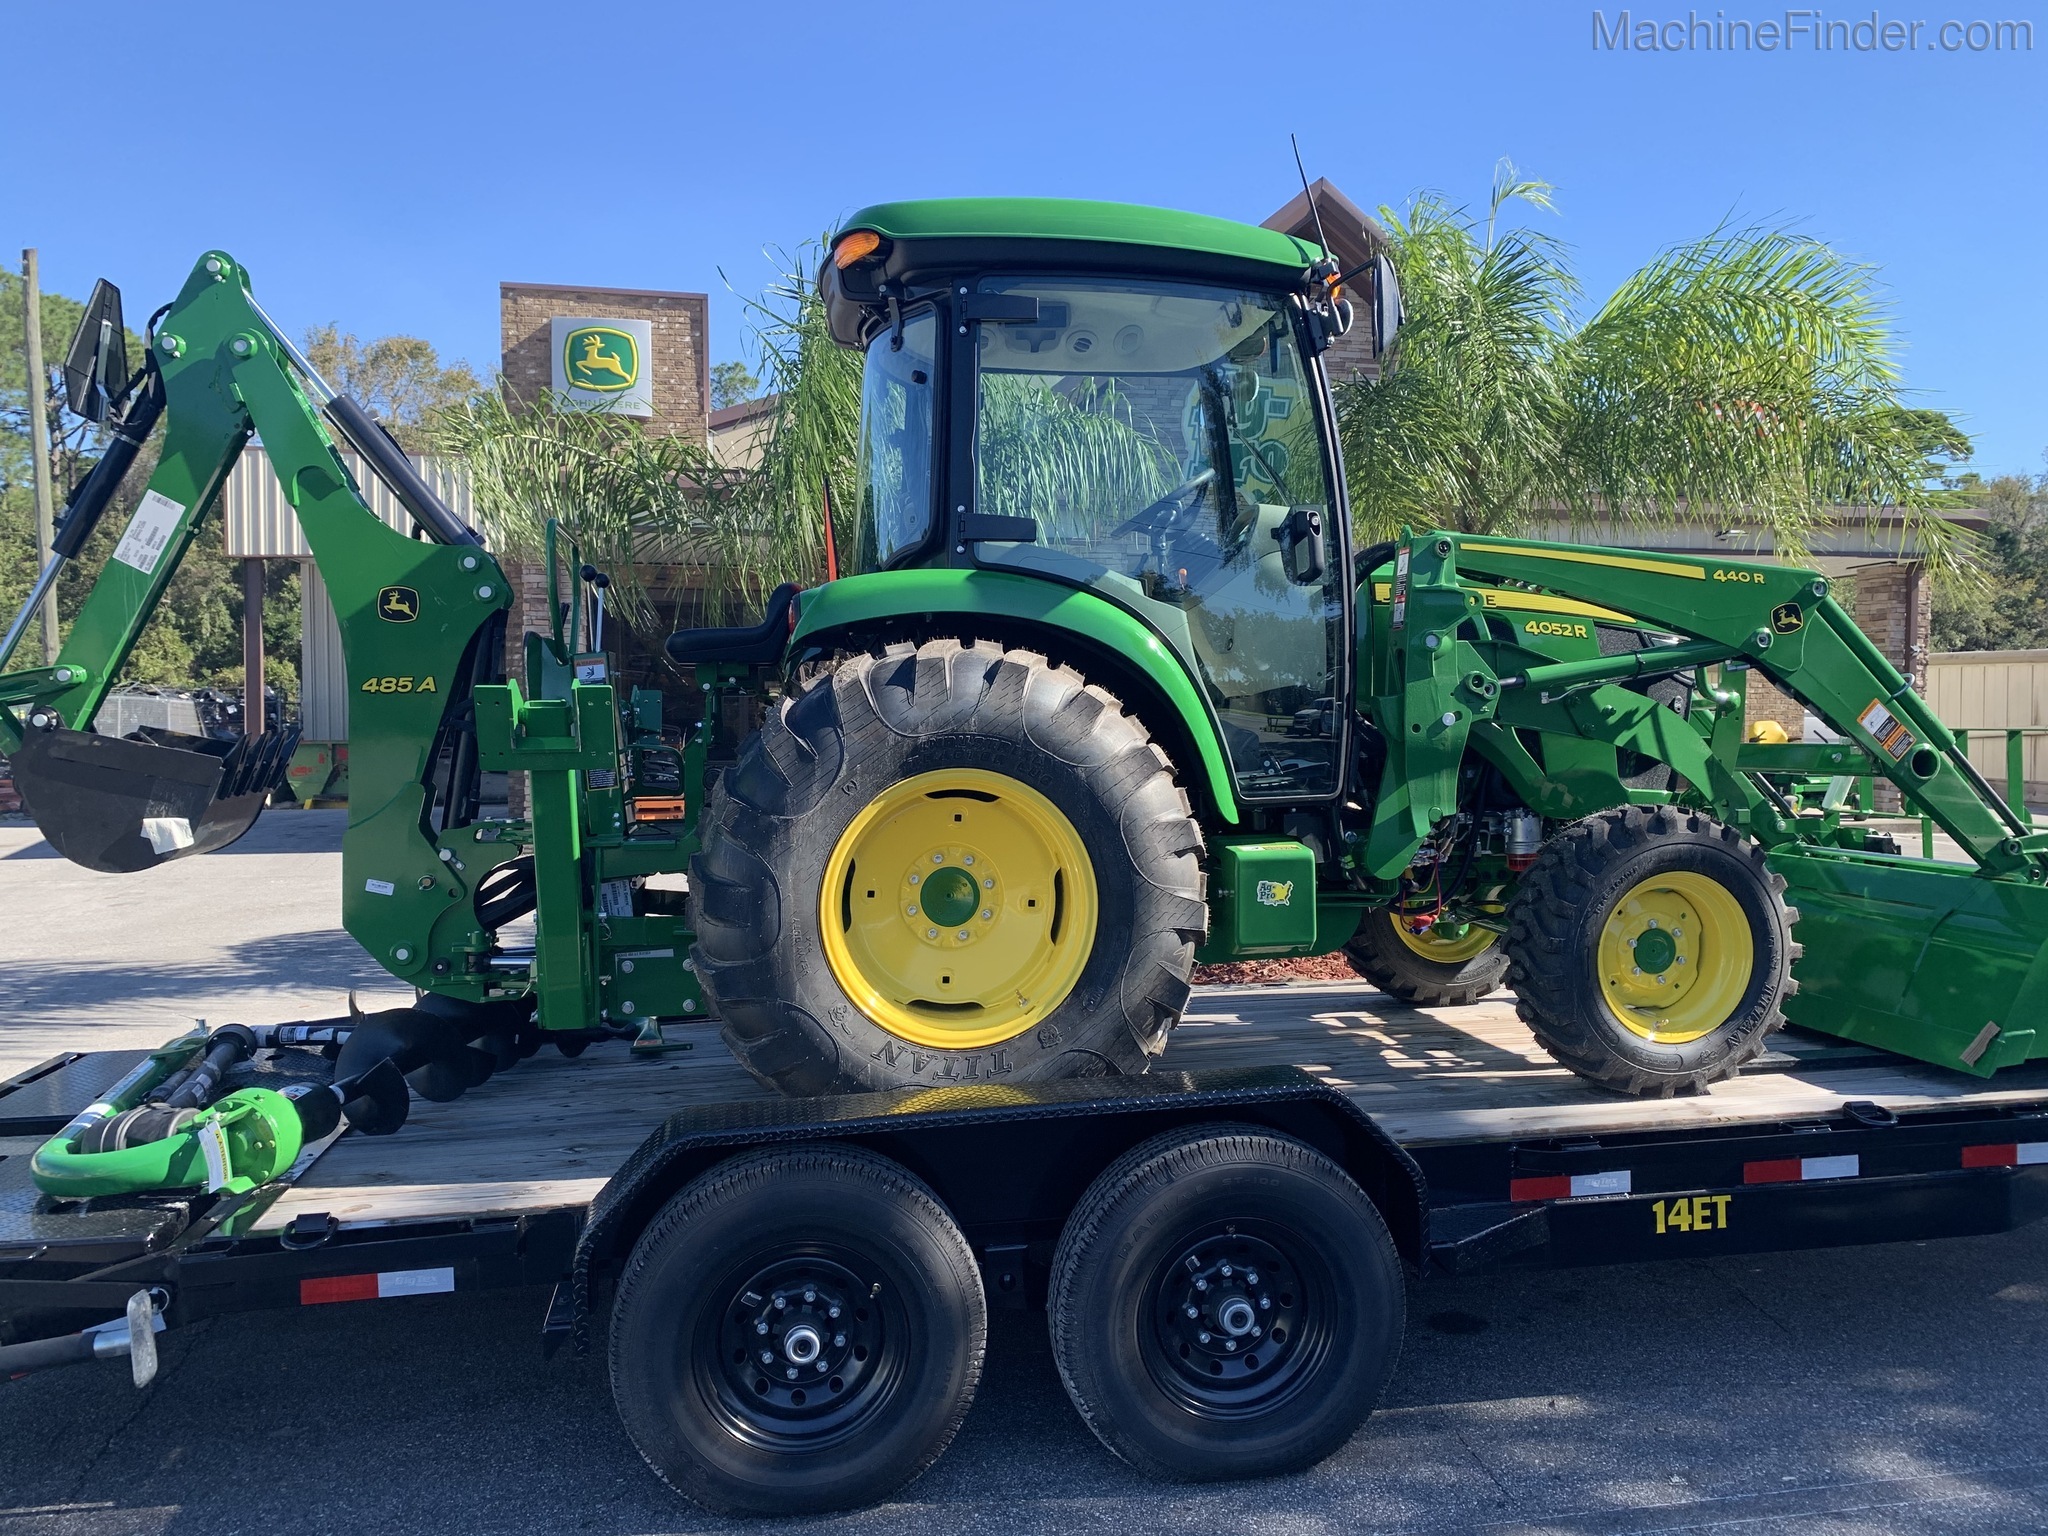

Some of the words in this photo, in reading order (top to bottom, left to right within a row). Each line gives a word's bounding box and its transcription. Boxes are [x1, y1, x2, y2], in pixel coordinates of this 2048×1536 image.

[1712, 569, 1751, 583] 440
[1753, 573, 1766, 584] R
[1524, 620, 1573, 637] 4052
[1573, 624, 1588, 639] R
[361, 676, 414, 694] 485
[415, 675, 437, 693] A
[1259, 892, 1276, 900] Pro
[871, 1039, 1014, 1081] TITAN
[1652, 1195, 1732, 1234] 14ET
